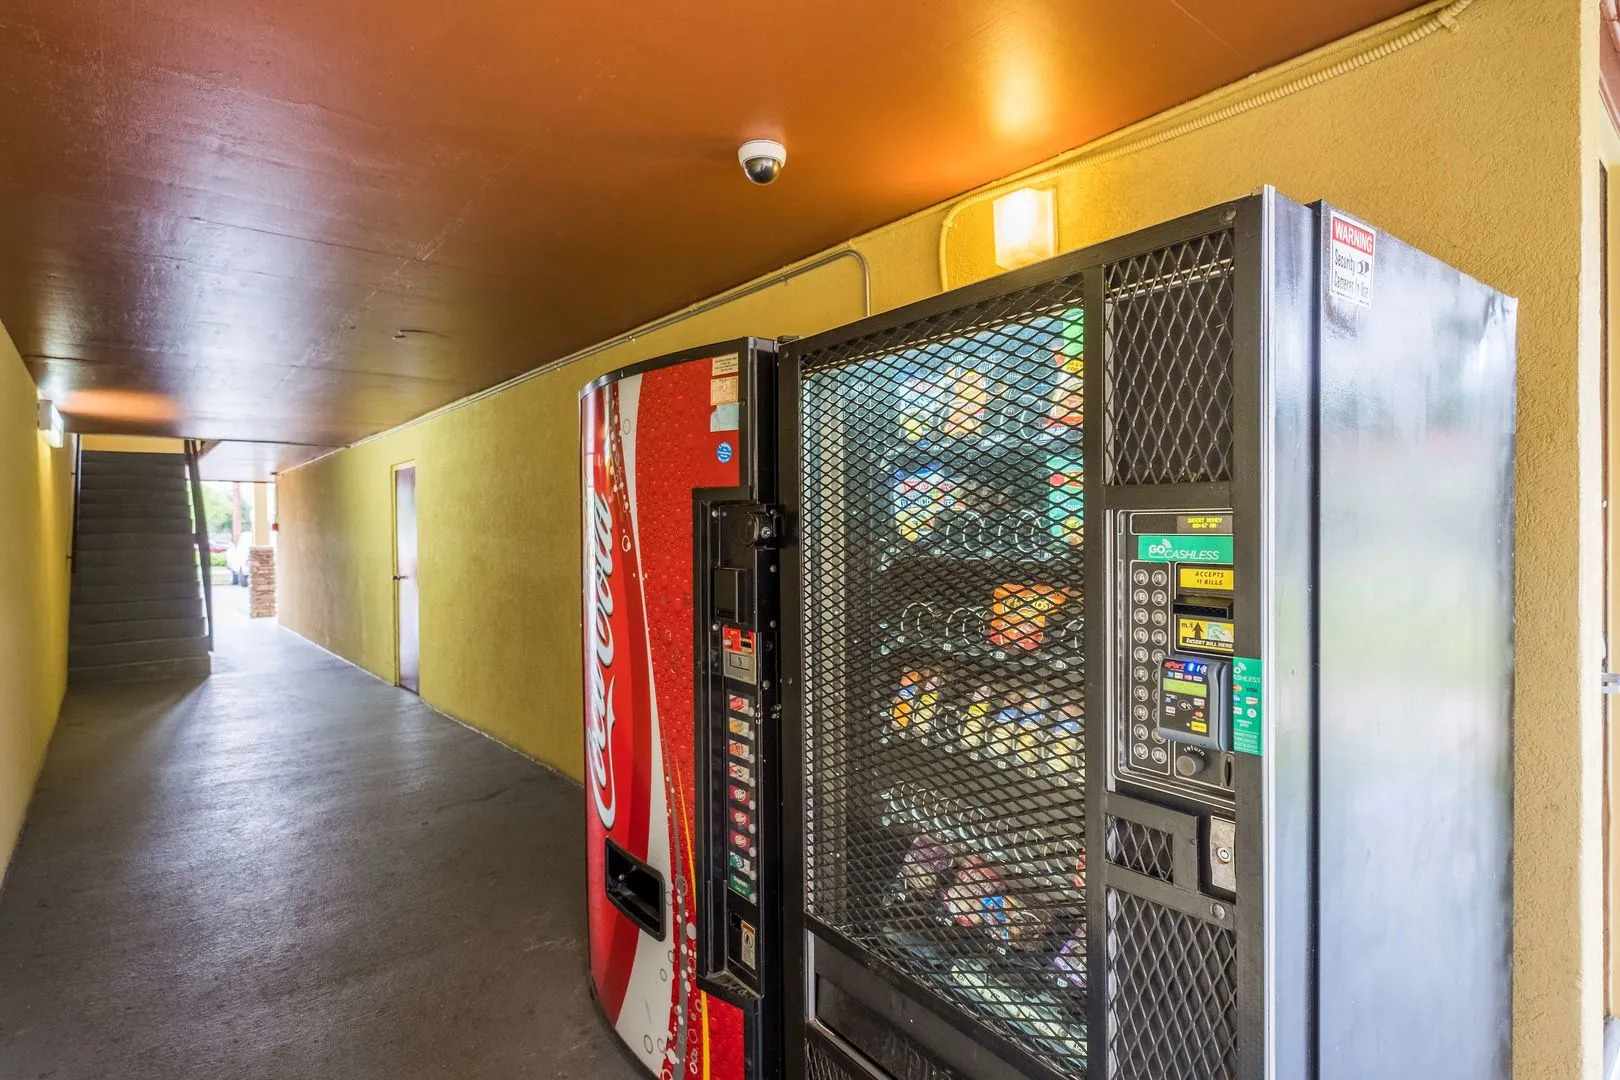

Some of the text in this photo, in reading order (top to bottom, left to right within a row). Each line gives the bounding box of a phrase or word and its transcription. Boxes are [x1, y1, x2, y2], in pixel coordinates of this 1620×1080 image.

[1334, 218, 1373, 254] WARNING
[1334, 248, 1356, 276] Security
[1148, 544, 1220, 560] GO CASHLESS
[1186, 637, 1206, 645] INSERT
[1184, 745, 1205, 757] return
